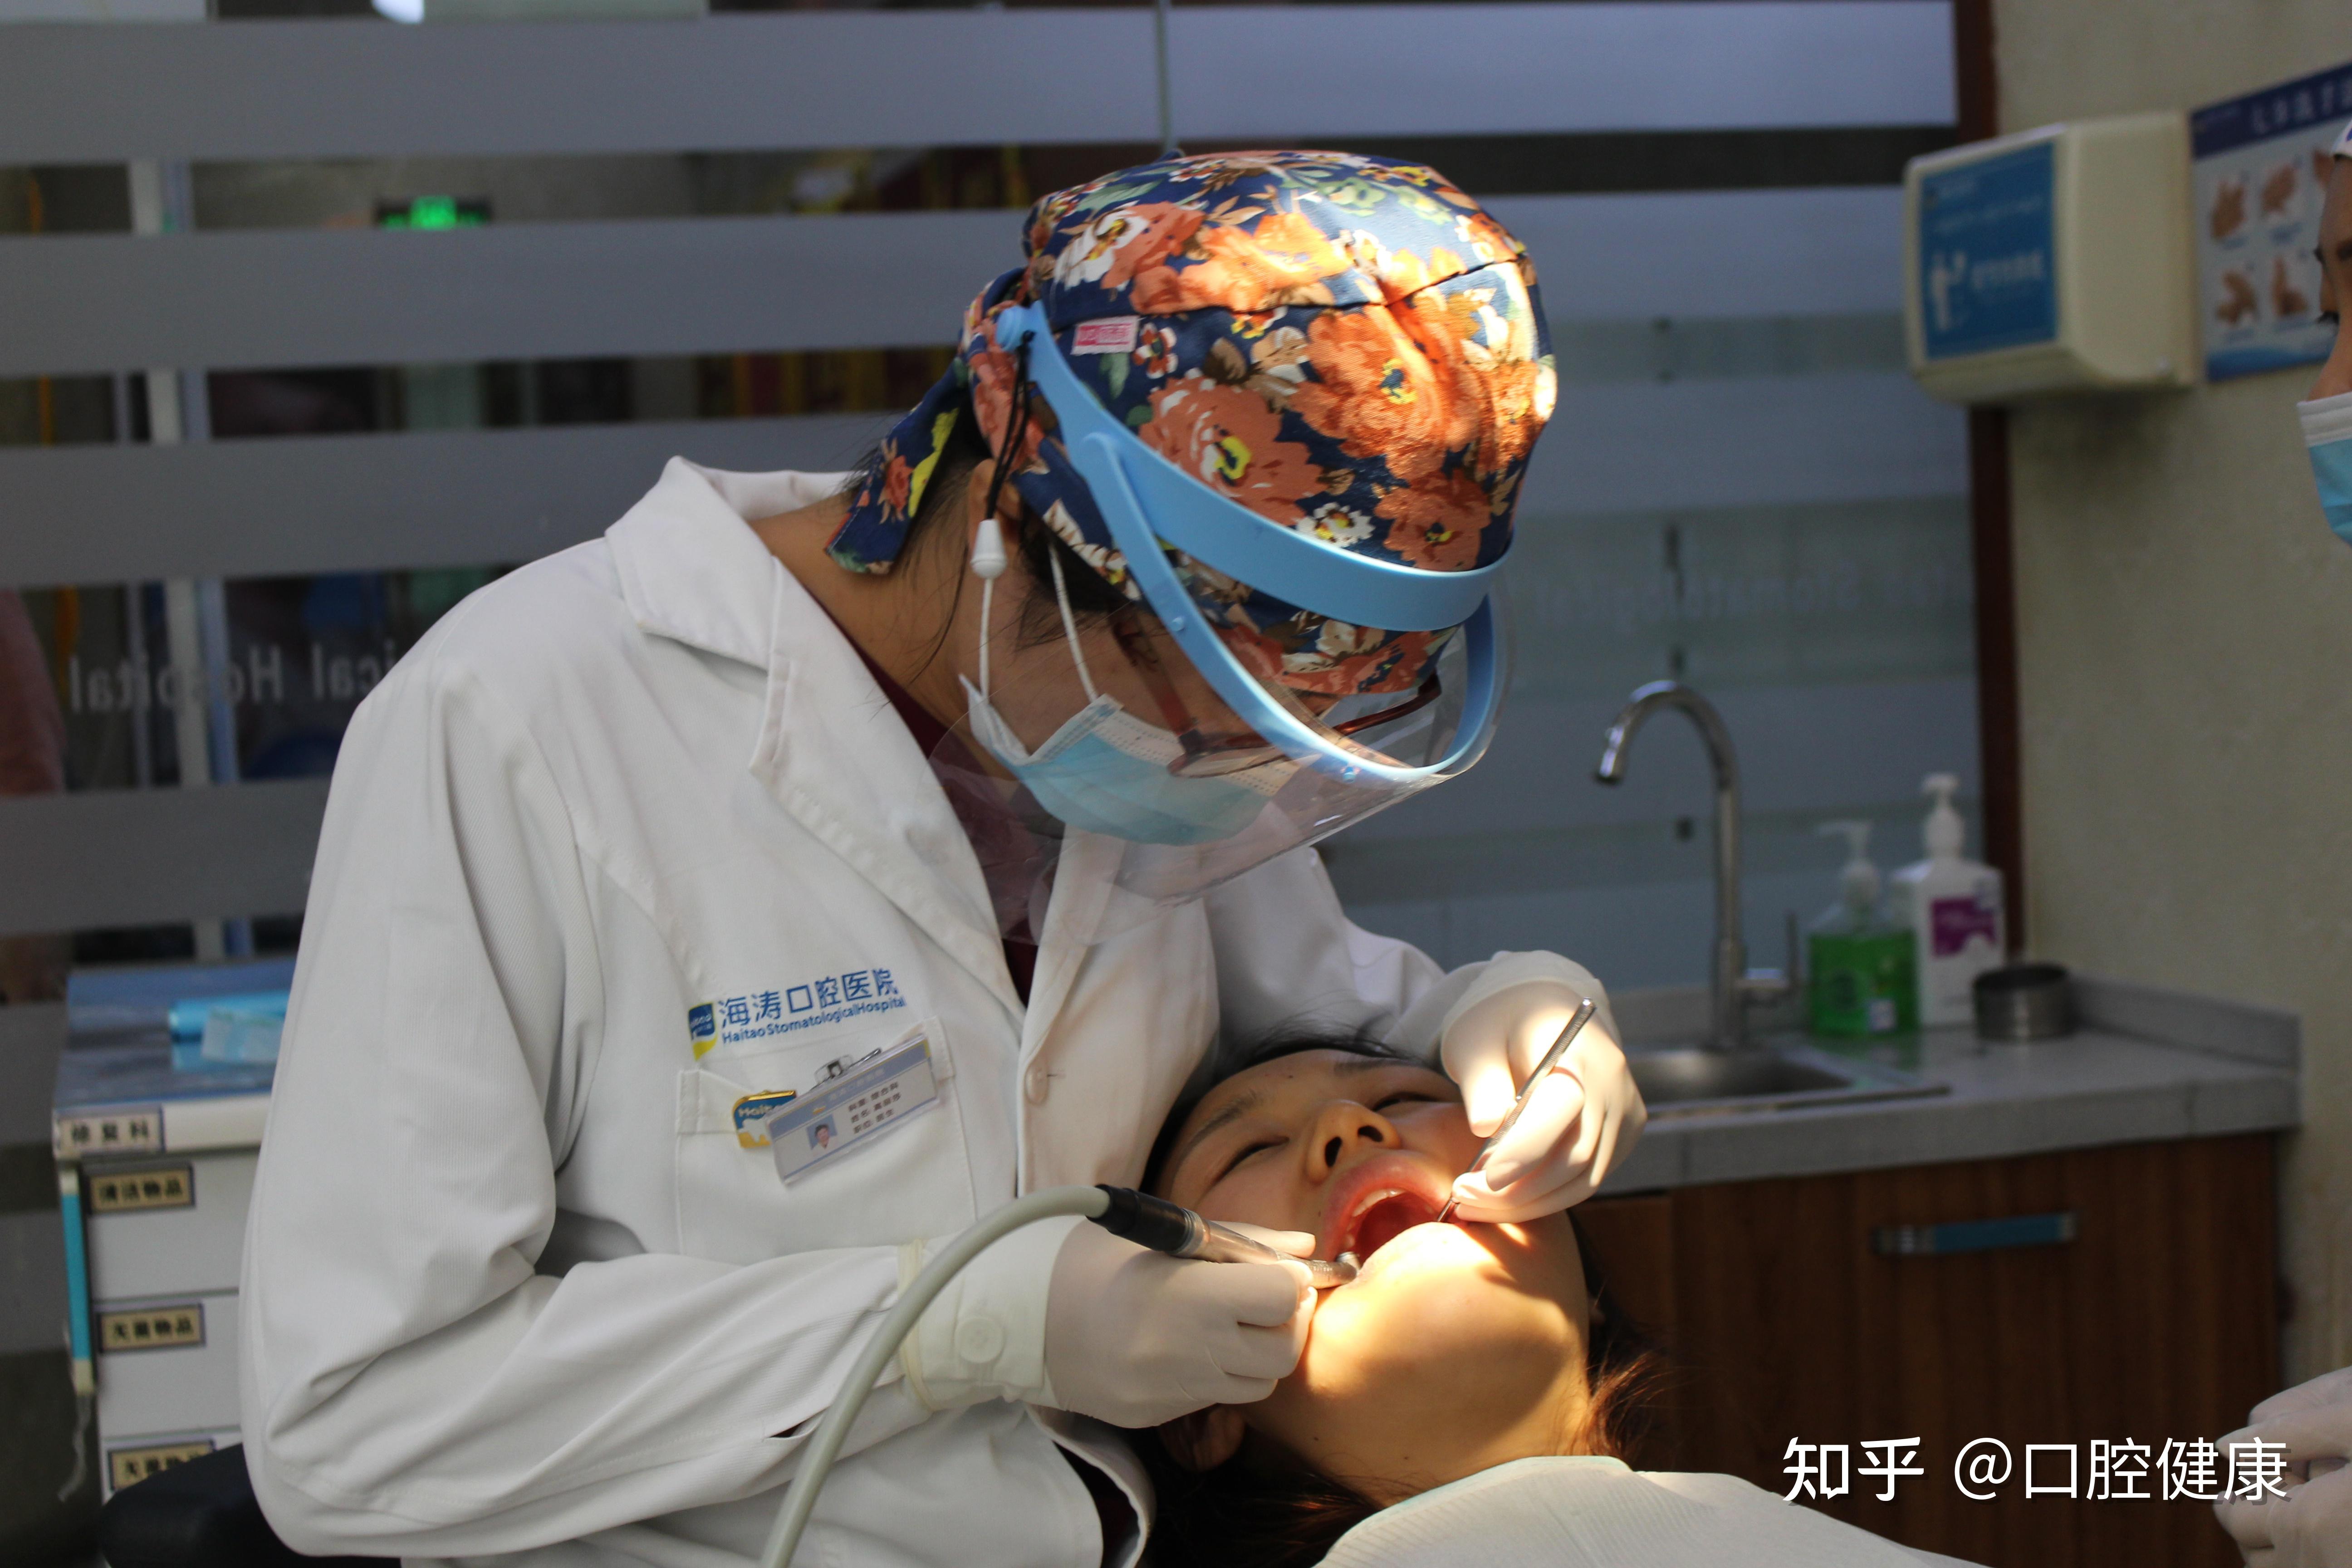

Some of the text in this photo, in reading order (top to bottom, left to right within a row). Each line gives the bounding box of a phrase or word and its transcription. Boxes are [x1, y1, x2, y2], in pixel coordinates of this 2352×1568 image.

[719, 968, 900, 1029] 海涛口腔医院
